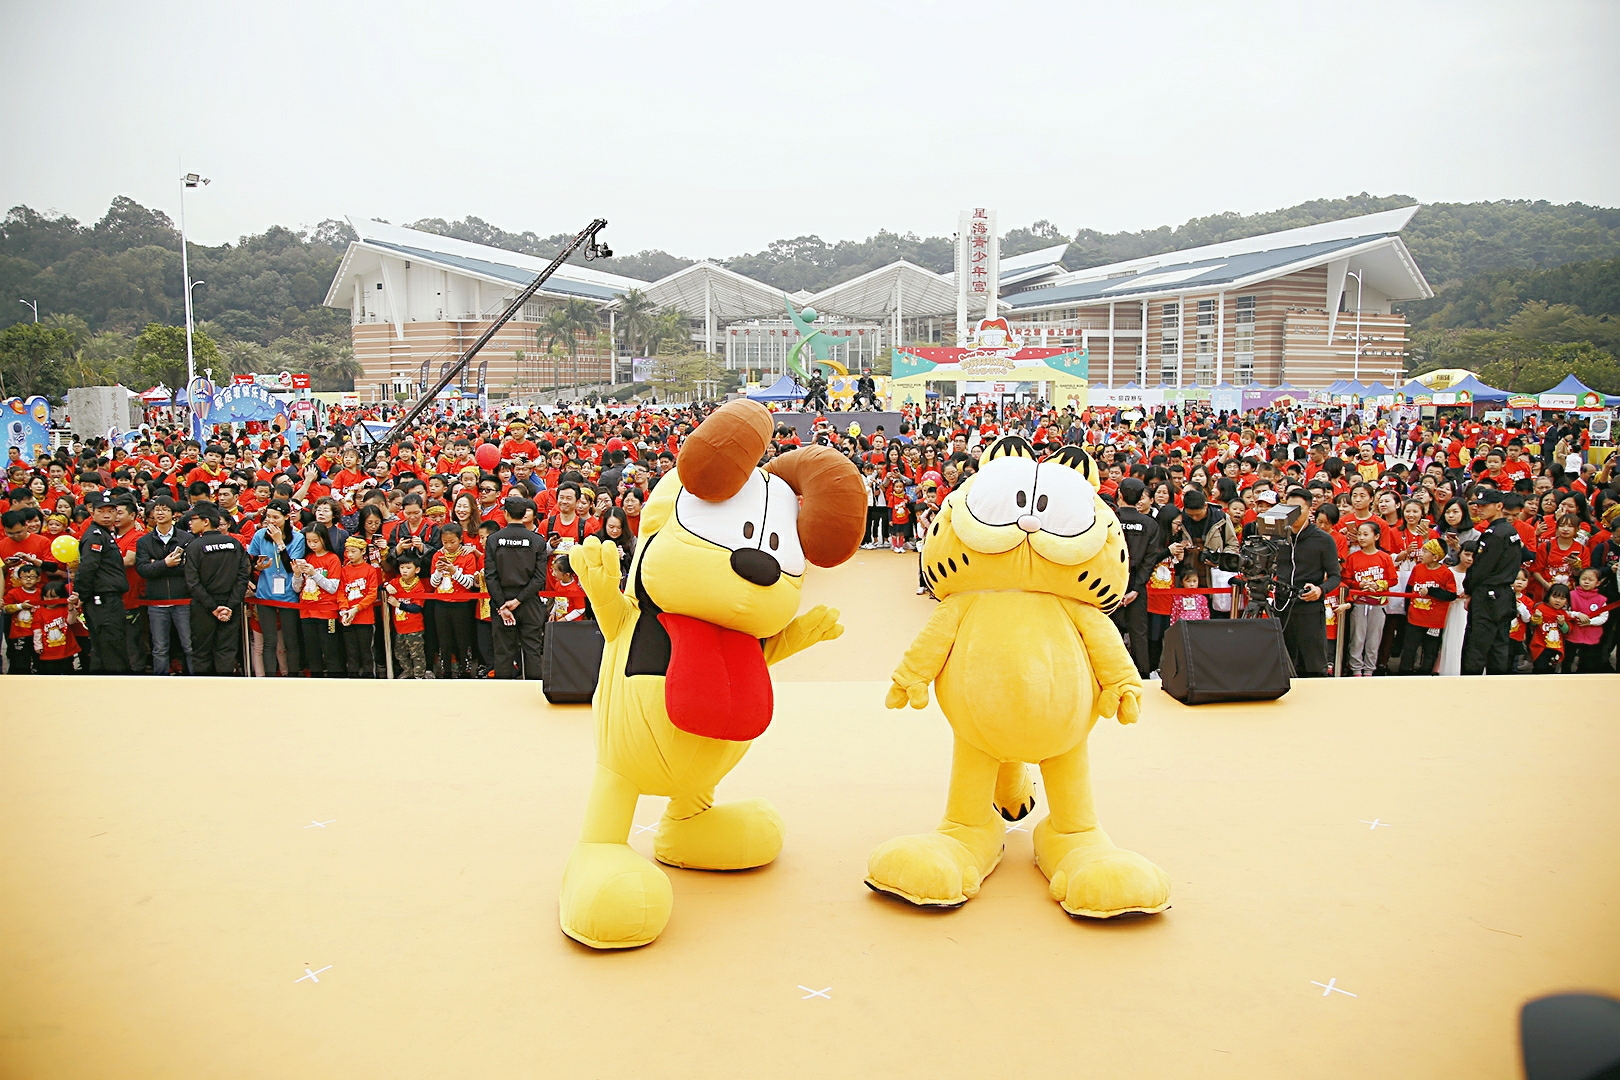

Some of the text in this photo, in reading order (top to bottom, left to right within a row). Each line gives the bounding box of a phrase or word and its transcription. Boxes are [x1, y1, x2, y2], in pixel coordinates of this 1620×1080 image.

[971, 208, 988, 292] 星海青少年宫
